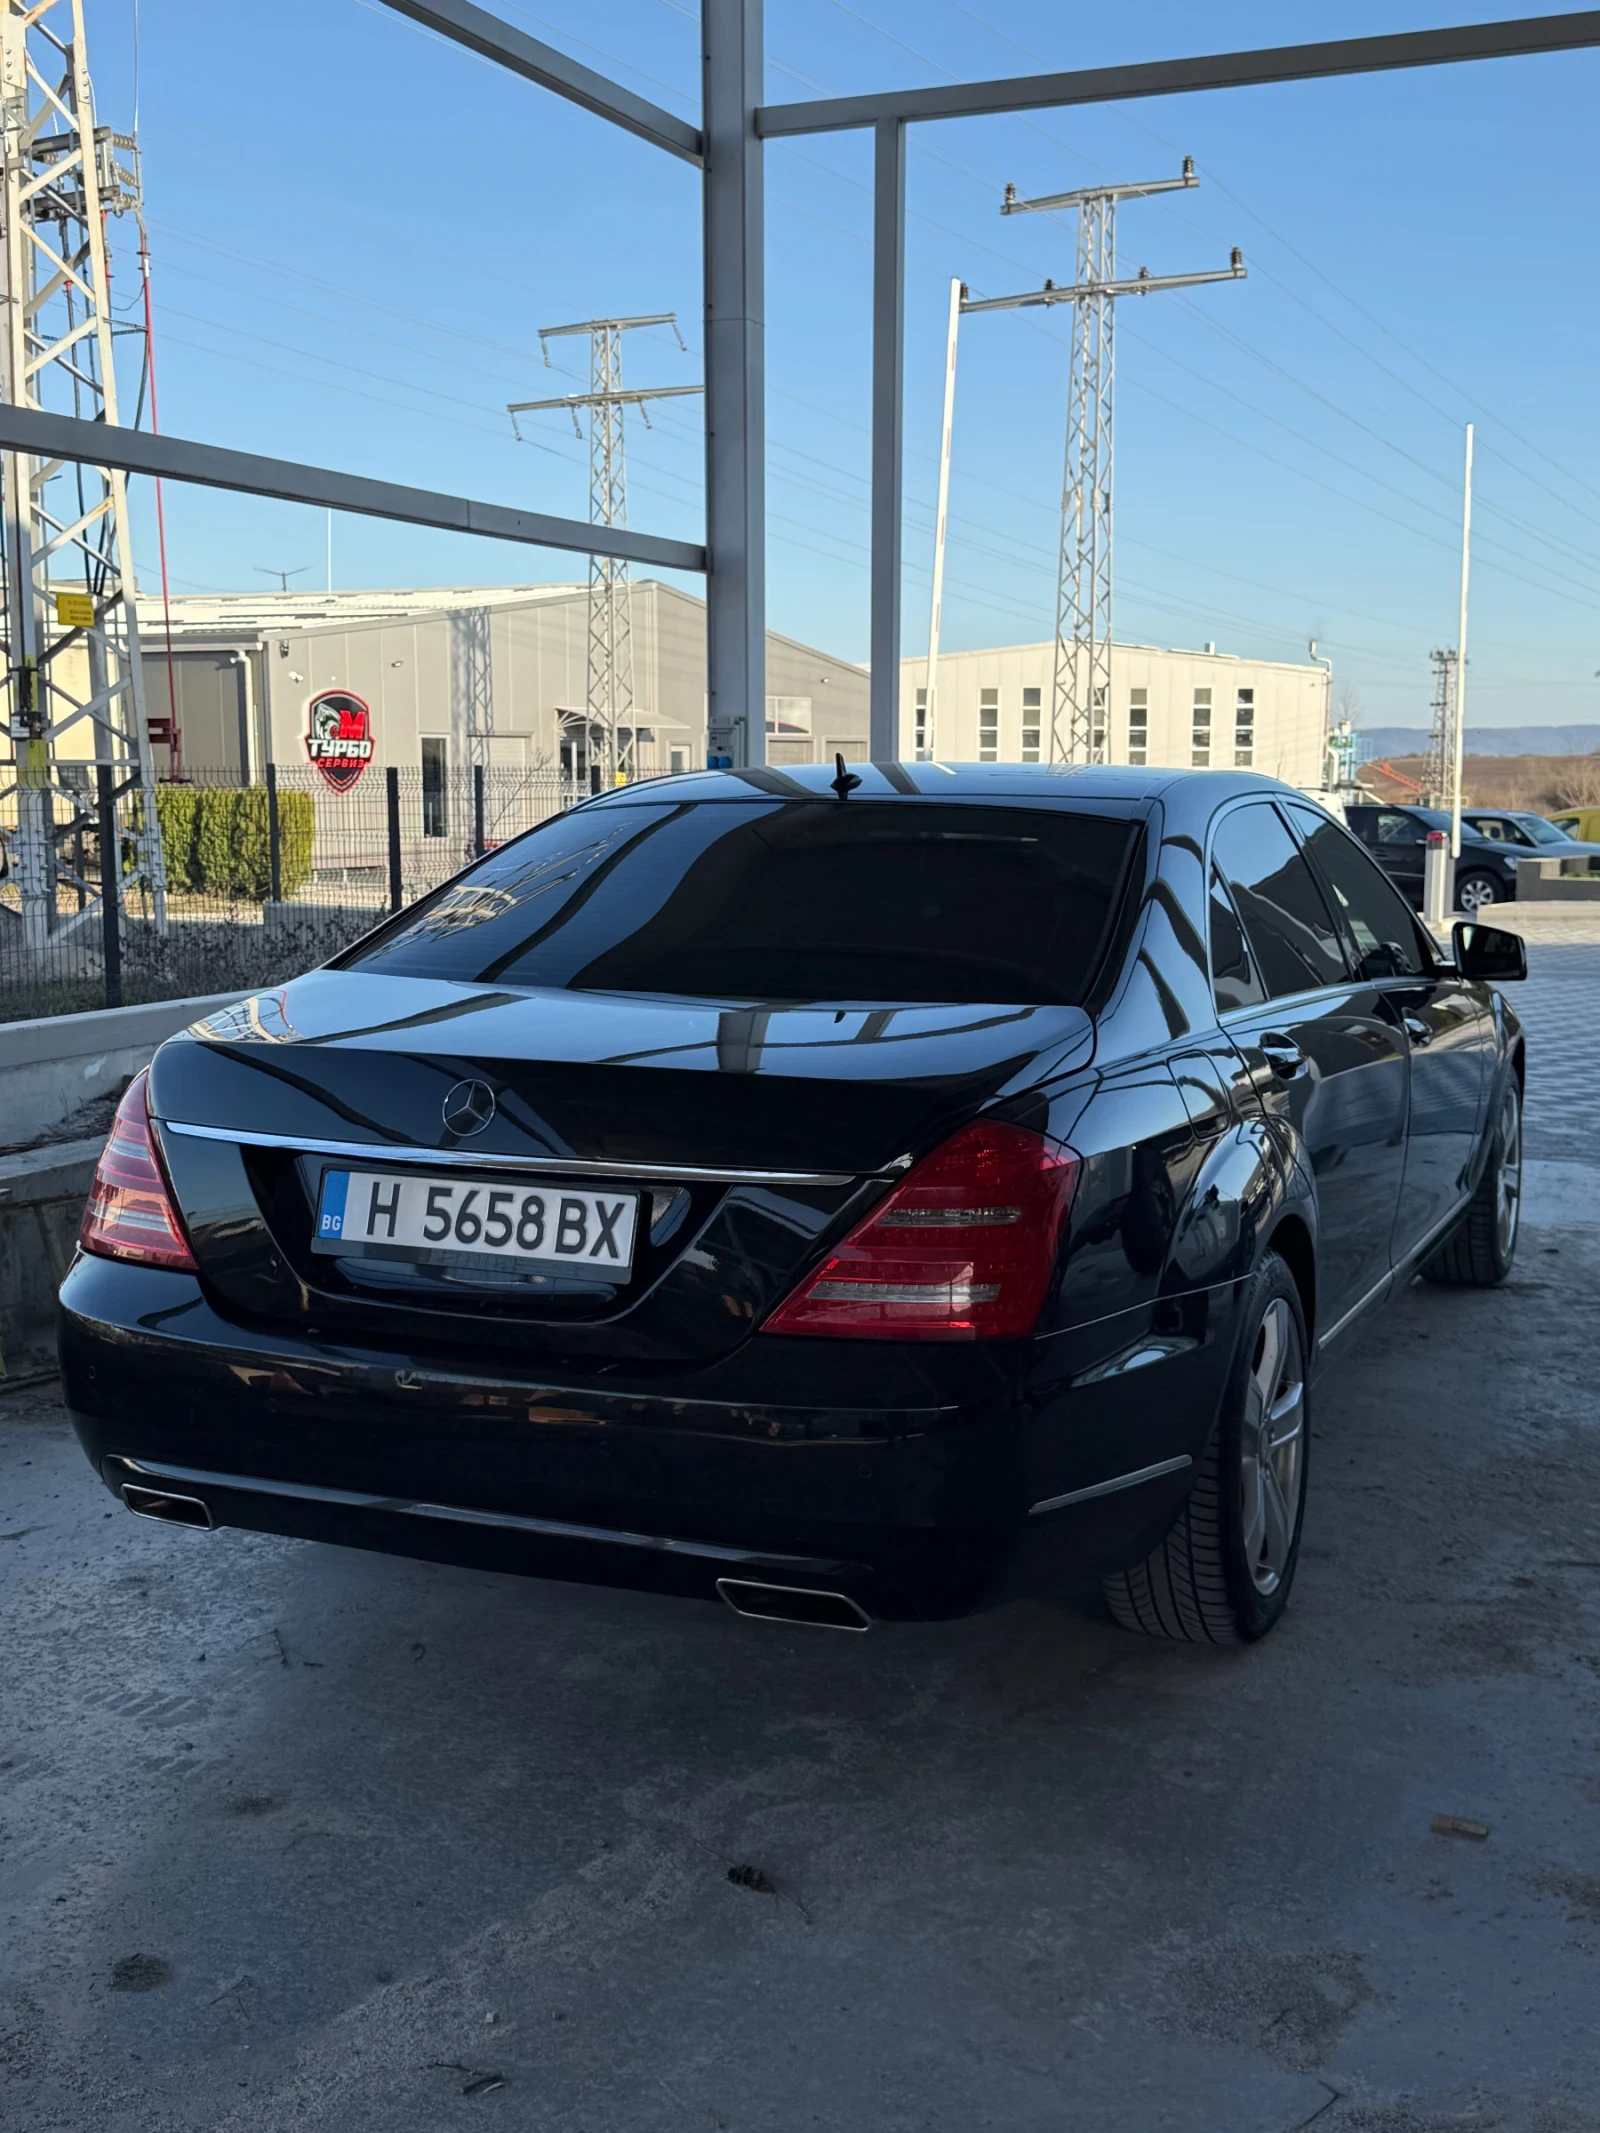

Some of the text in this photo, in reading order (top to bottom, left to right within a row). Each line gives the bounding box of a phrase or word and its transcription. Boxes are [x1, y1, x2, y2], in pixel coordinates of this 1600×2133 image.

[308, 740, 372, 758] ТУРБО
[317, 758, 365, 768] СЕРВИЗ
[321, 1214, 342, 1231] BG
[423, 1186, 546, 1250] 5658
